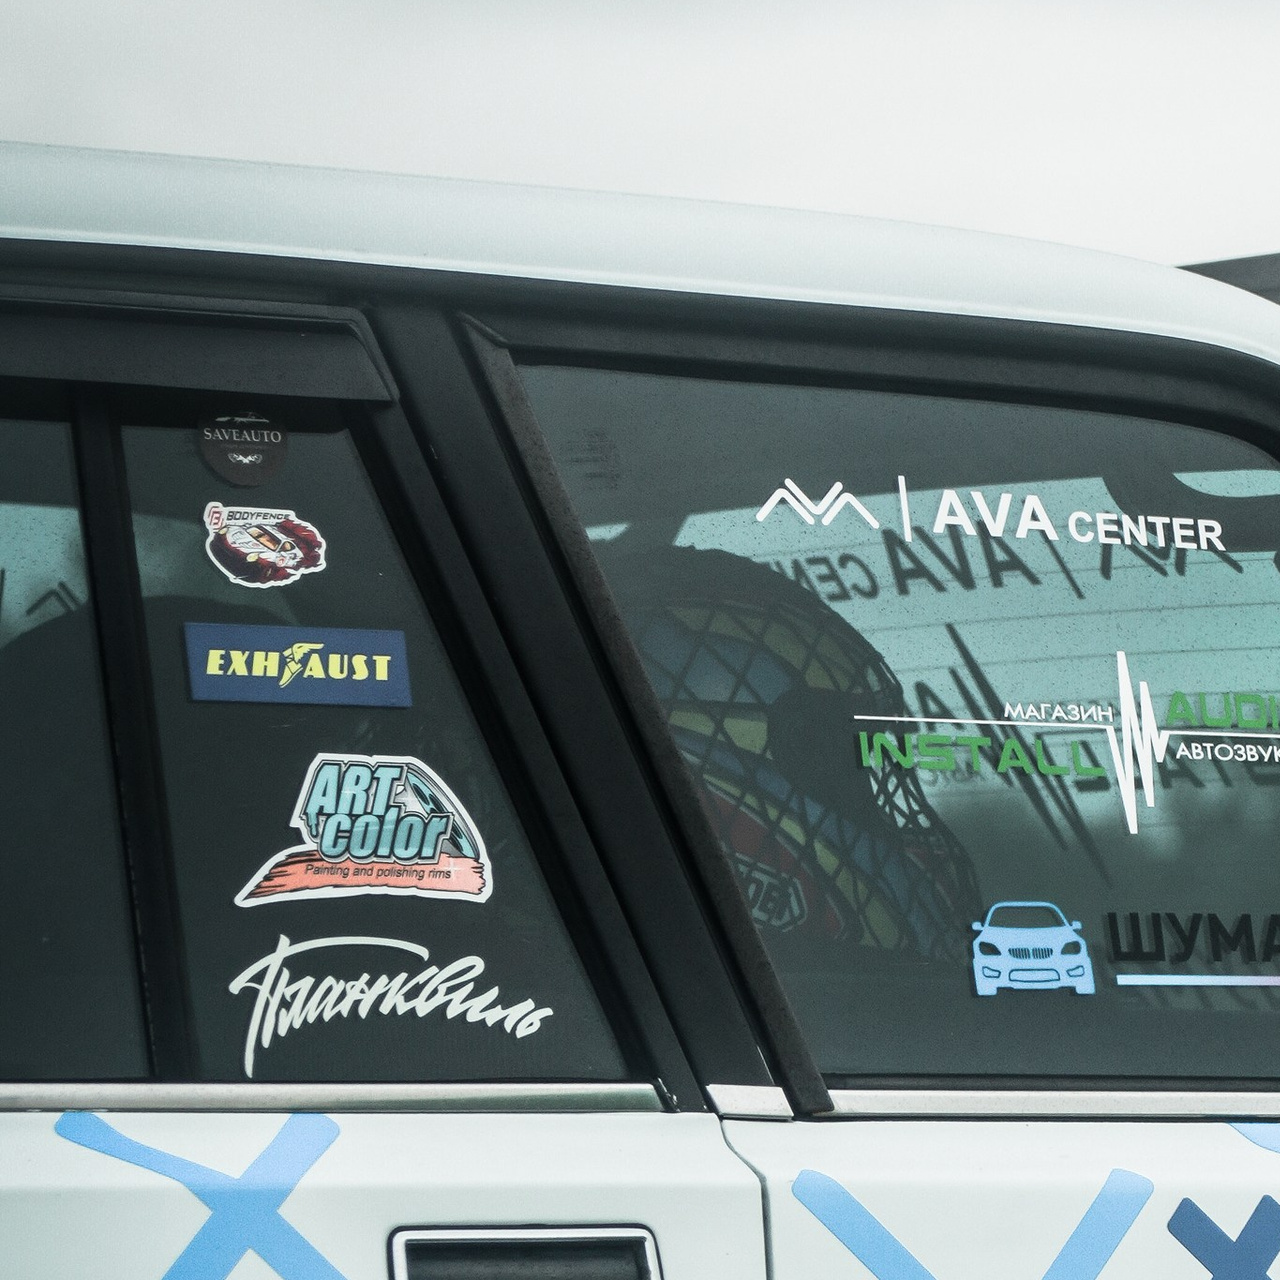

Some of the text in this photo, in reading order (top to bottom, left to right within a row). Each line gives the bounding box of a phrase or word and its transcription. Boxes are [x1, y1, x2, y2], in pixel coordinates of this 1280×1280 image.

[203, 427, 282, 443] SAVEAUTO
[227, 511, 290, 521] BODYFENCE
[932, 489, 1226, 551] AVA CENTER
[1004, 701, 1114, 723] МАГАЗИН
[858, 731, 1106, 777] INSTALL
[305, 761, 404, 820] ART
[305, 863, 451, 881] Painting and polishing rims
